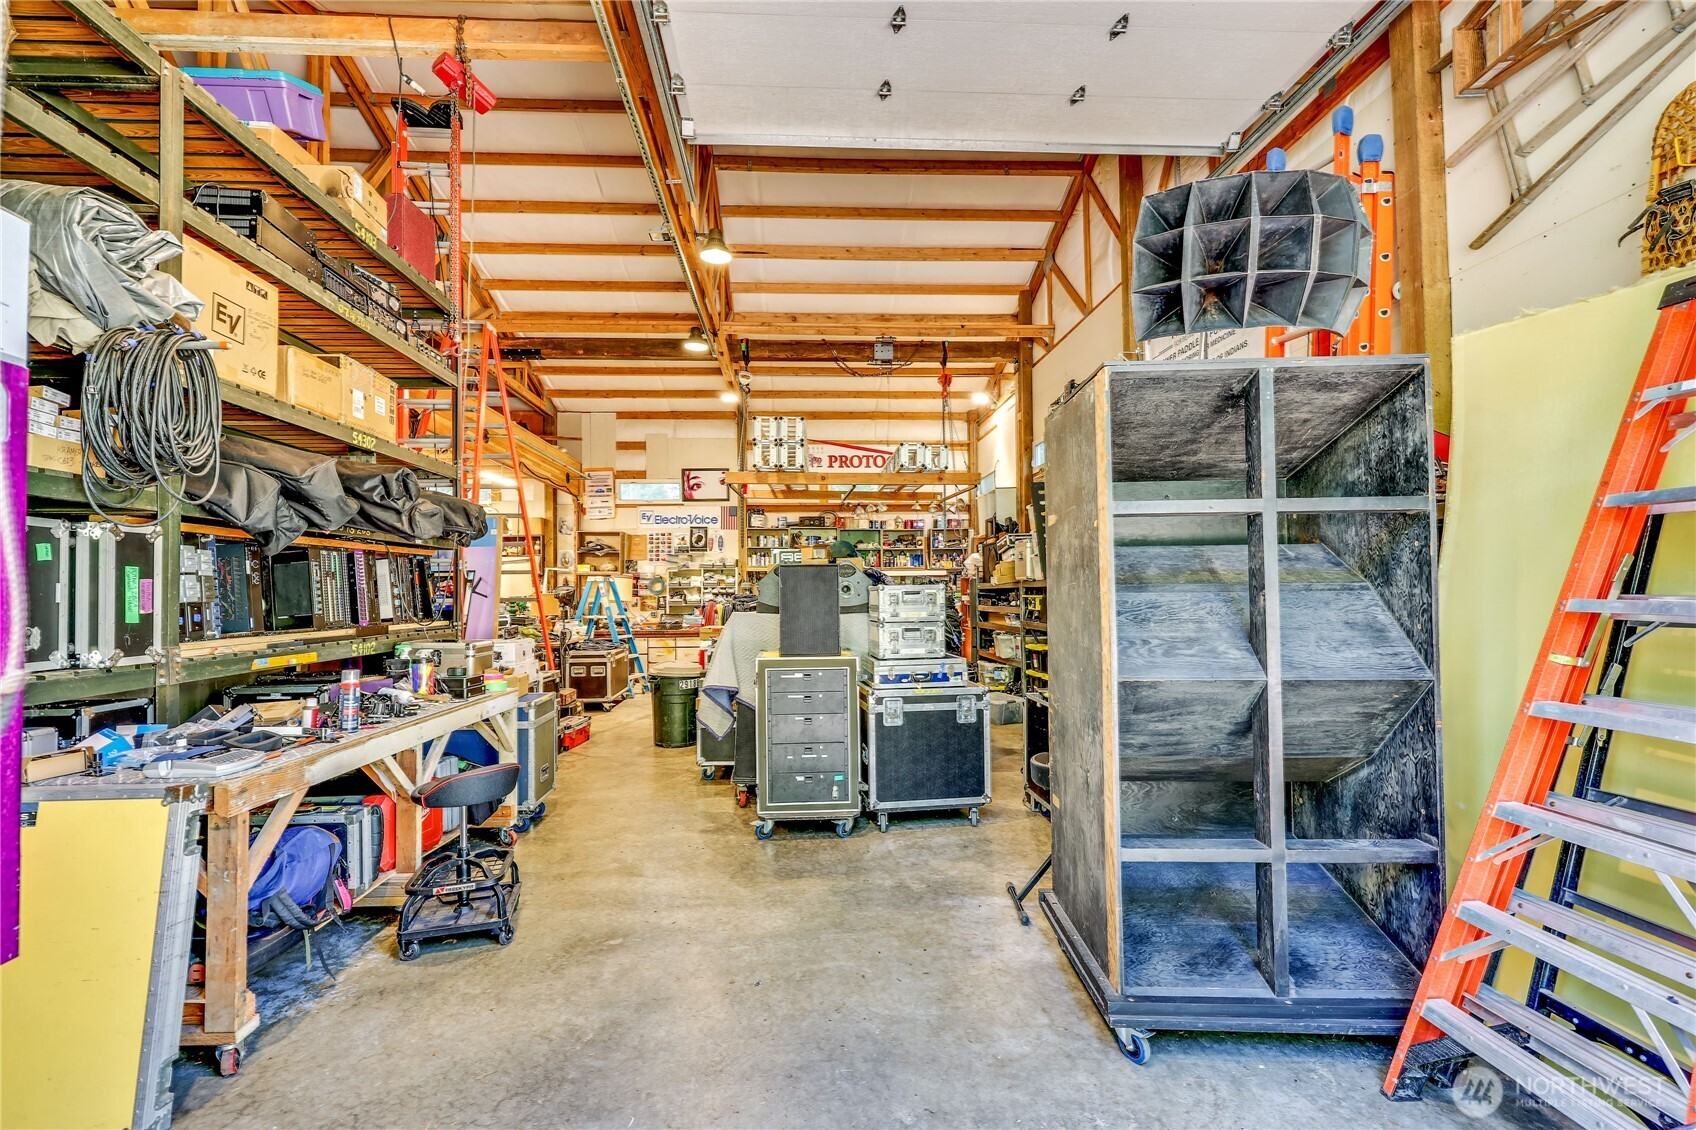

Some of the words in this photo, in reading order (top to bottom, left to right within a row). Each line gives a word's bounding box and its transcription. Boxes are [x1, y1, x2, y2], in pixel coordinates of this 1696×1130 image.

[216, 301, 242, 335] EV
[1210, 329, 1236, 347] MEDICINE
[1177, 337, 1200, 358] PADDLE
[1223, 340, 1248, 358] INDIANS
[352, 431, 376, 451] 54302
[641, 513, 652, 522] EV
[352, 642, 376, 656] 54102
